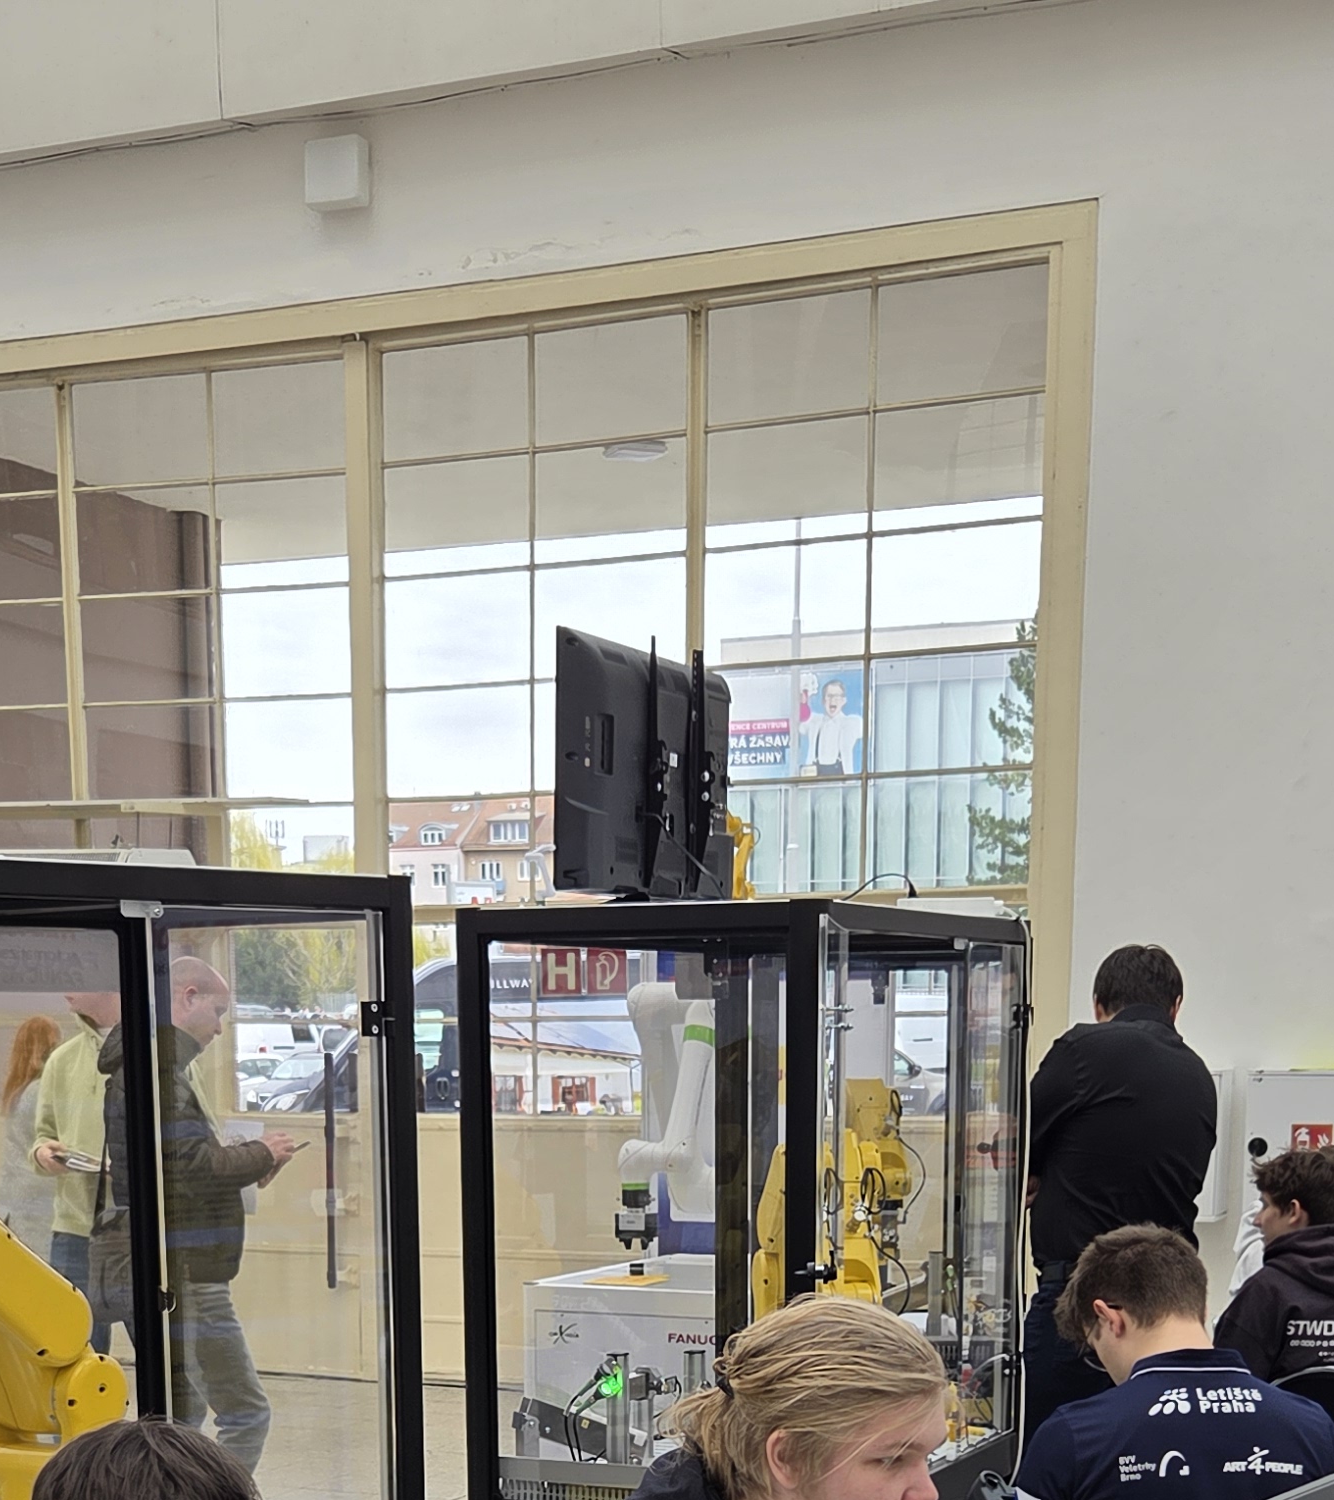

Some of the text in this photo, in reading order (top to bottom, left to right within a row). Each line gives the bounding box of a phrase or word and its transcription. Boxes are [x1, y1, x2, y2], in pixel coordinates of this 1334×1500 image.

[752, 721, 788, 730] CENTRUM
[749, 734, 789, 748] ZÁBAV
[547, 953, 576, 991] H
[668, 1332, 716, 1346] FANUC
[1196, 1386, 1263, 1401] Letiště
[1199, 1400, 1256, 1414] Praha
[1120, 1472, 1142, 1482] Brno
